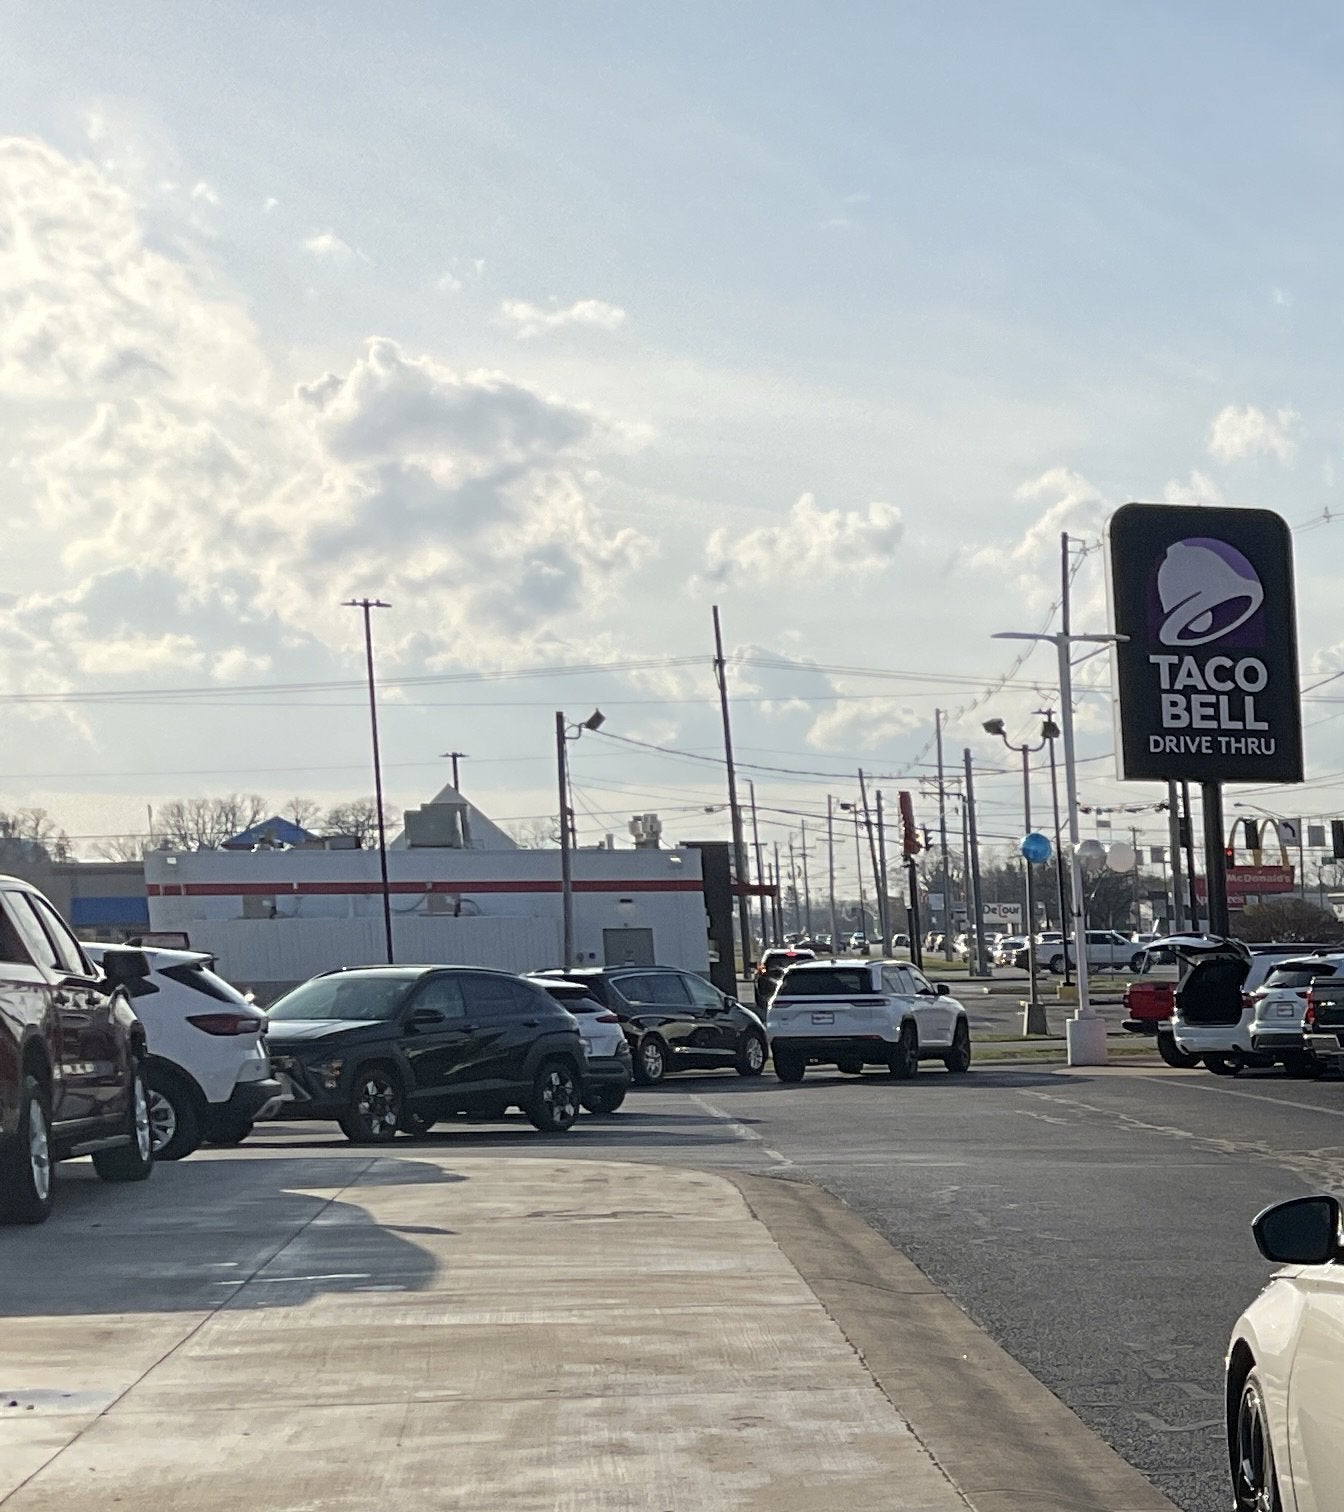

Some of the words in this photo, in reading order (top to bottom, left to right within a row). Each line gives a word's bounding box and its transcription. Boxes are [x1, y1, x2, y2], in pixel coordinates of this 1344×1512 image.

[1149, 653, 1268, 693] TACO
[1161, 693, 1269, 731] BELL
[1149, 734, 1212, 753] DRIVE
[1217, 736, 1276, 755] THRU
[1226, 873, 1291, 883] McDonald's
[983, 904, 1019, 918] DeTour
